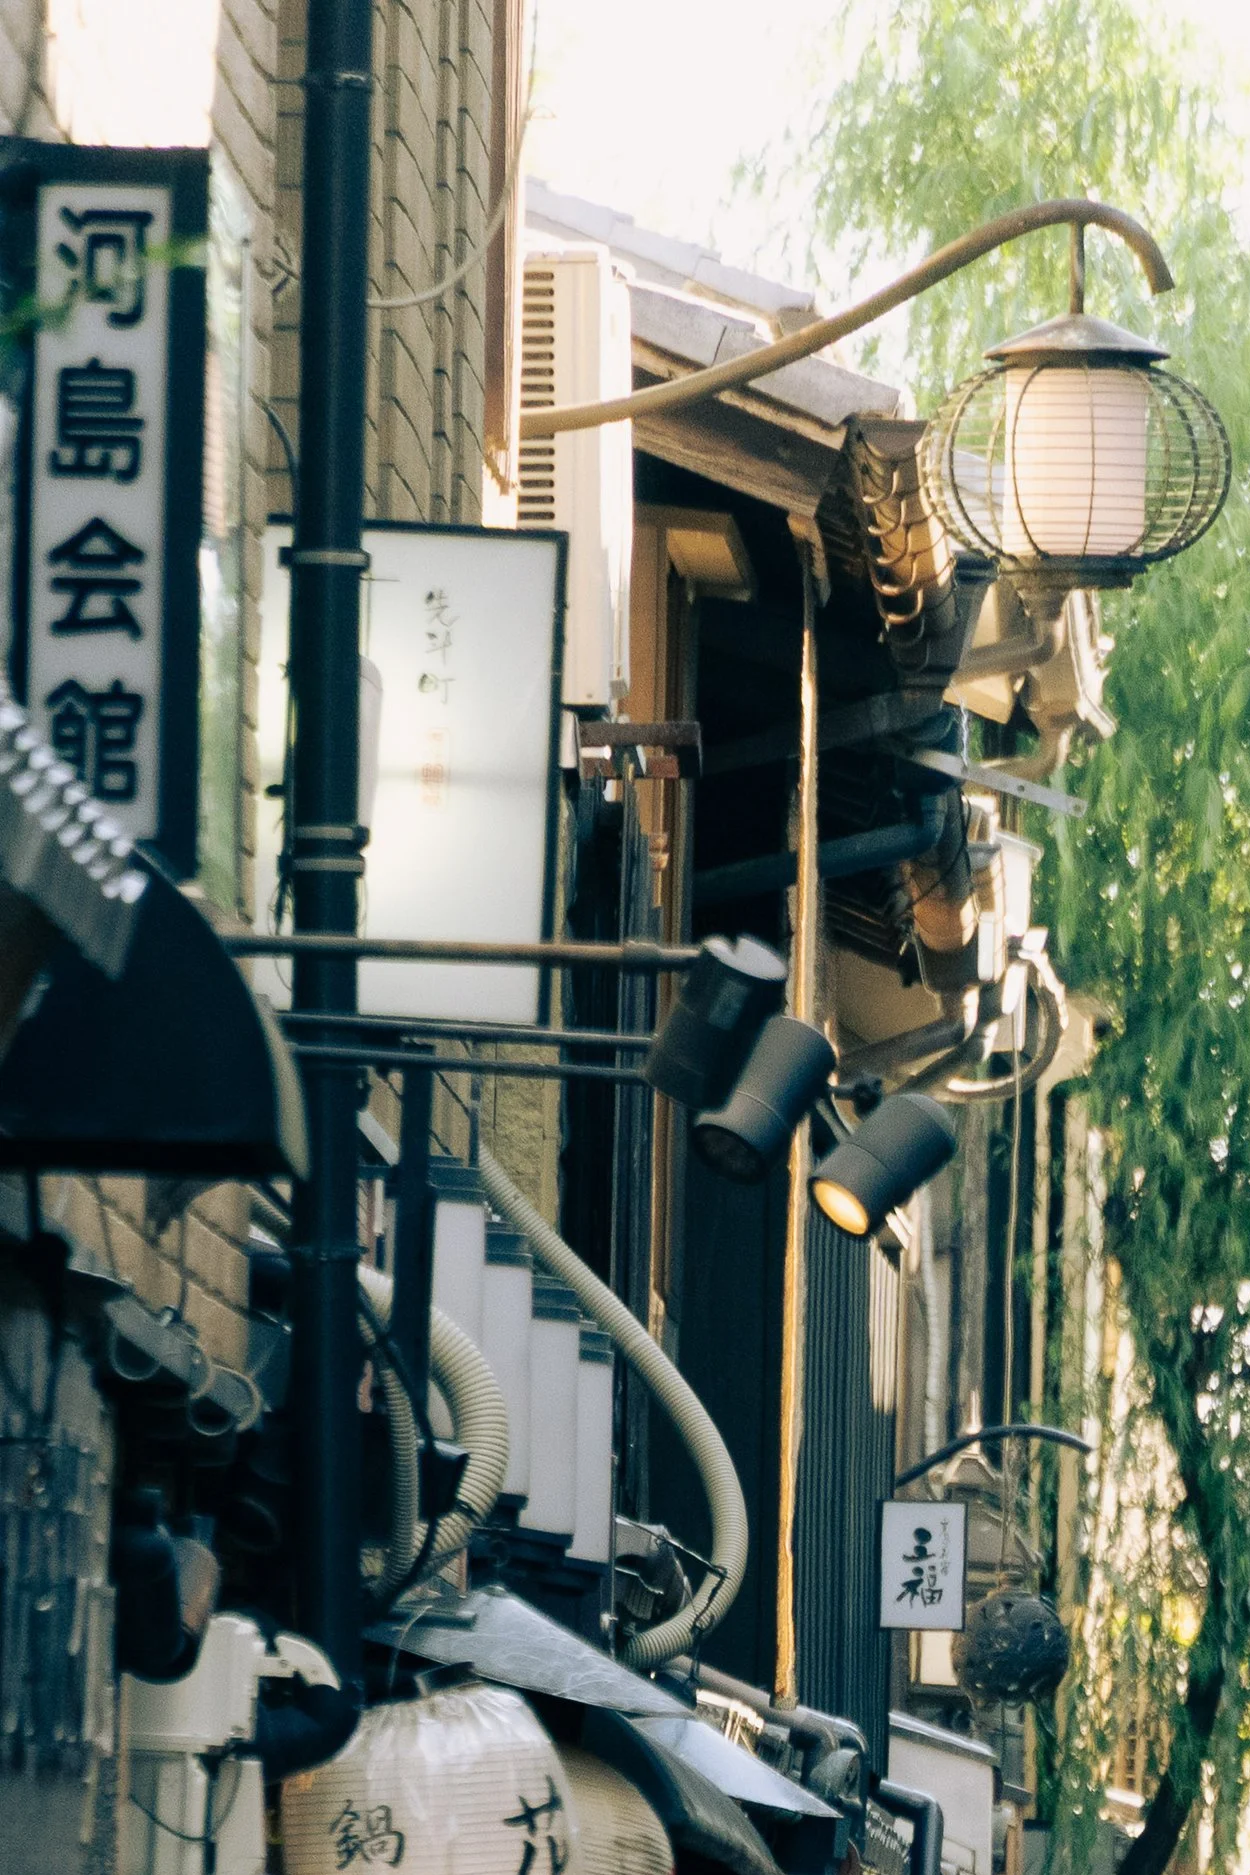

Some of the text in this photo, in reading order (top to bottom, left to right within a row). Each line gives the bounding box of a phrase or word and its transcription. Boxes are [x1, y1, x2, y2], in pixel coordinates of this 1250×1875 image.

[47, 206, 154, 804] 河島会館
[418, 589, 461, 705] 先斗町
[895, 1526, 944, 1610] 三福
